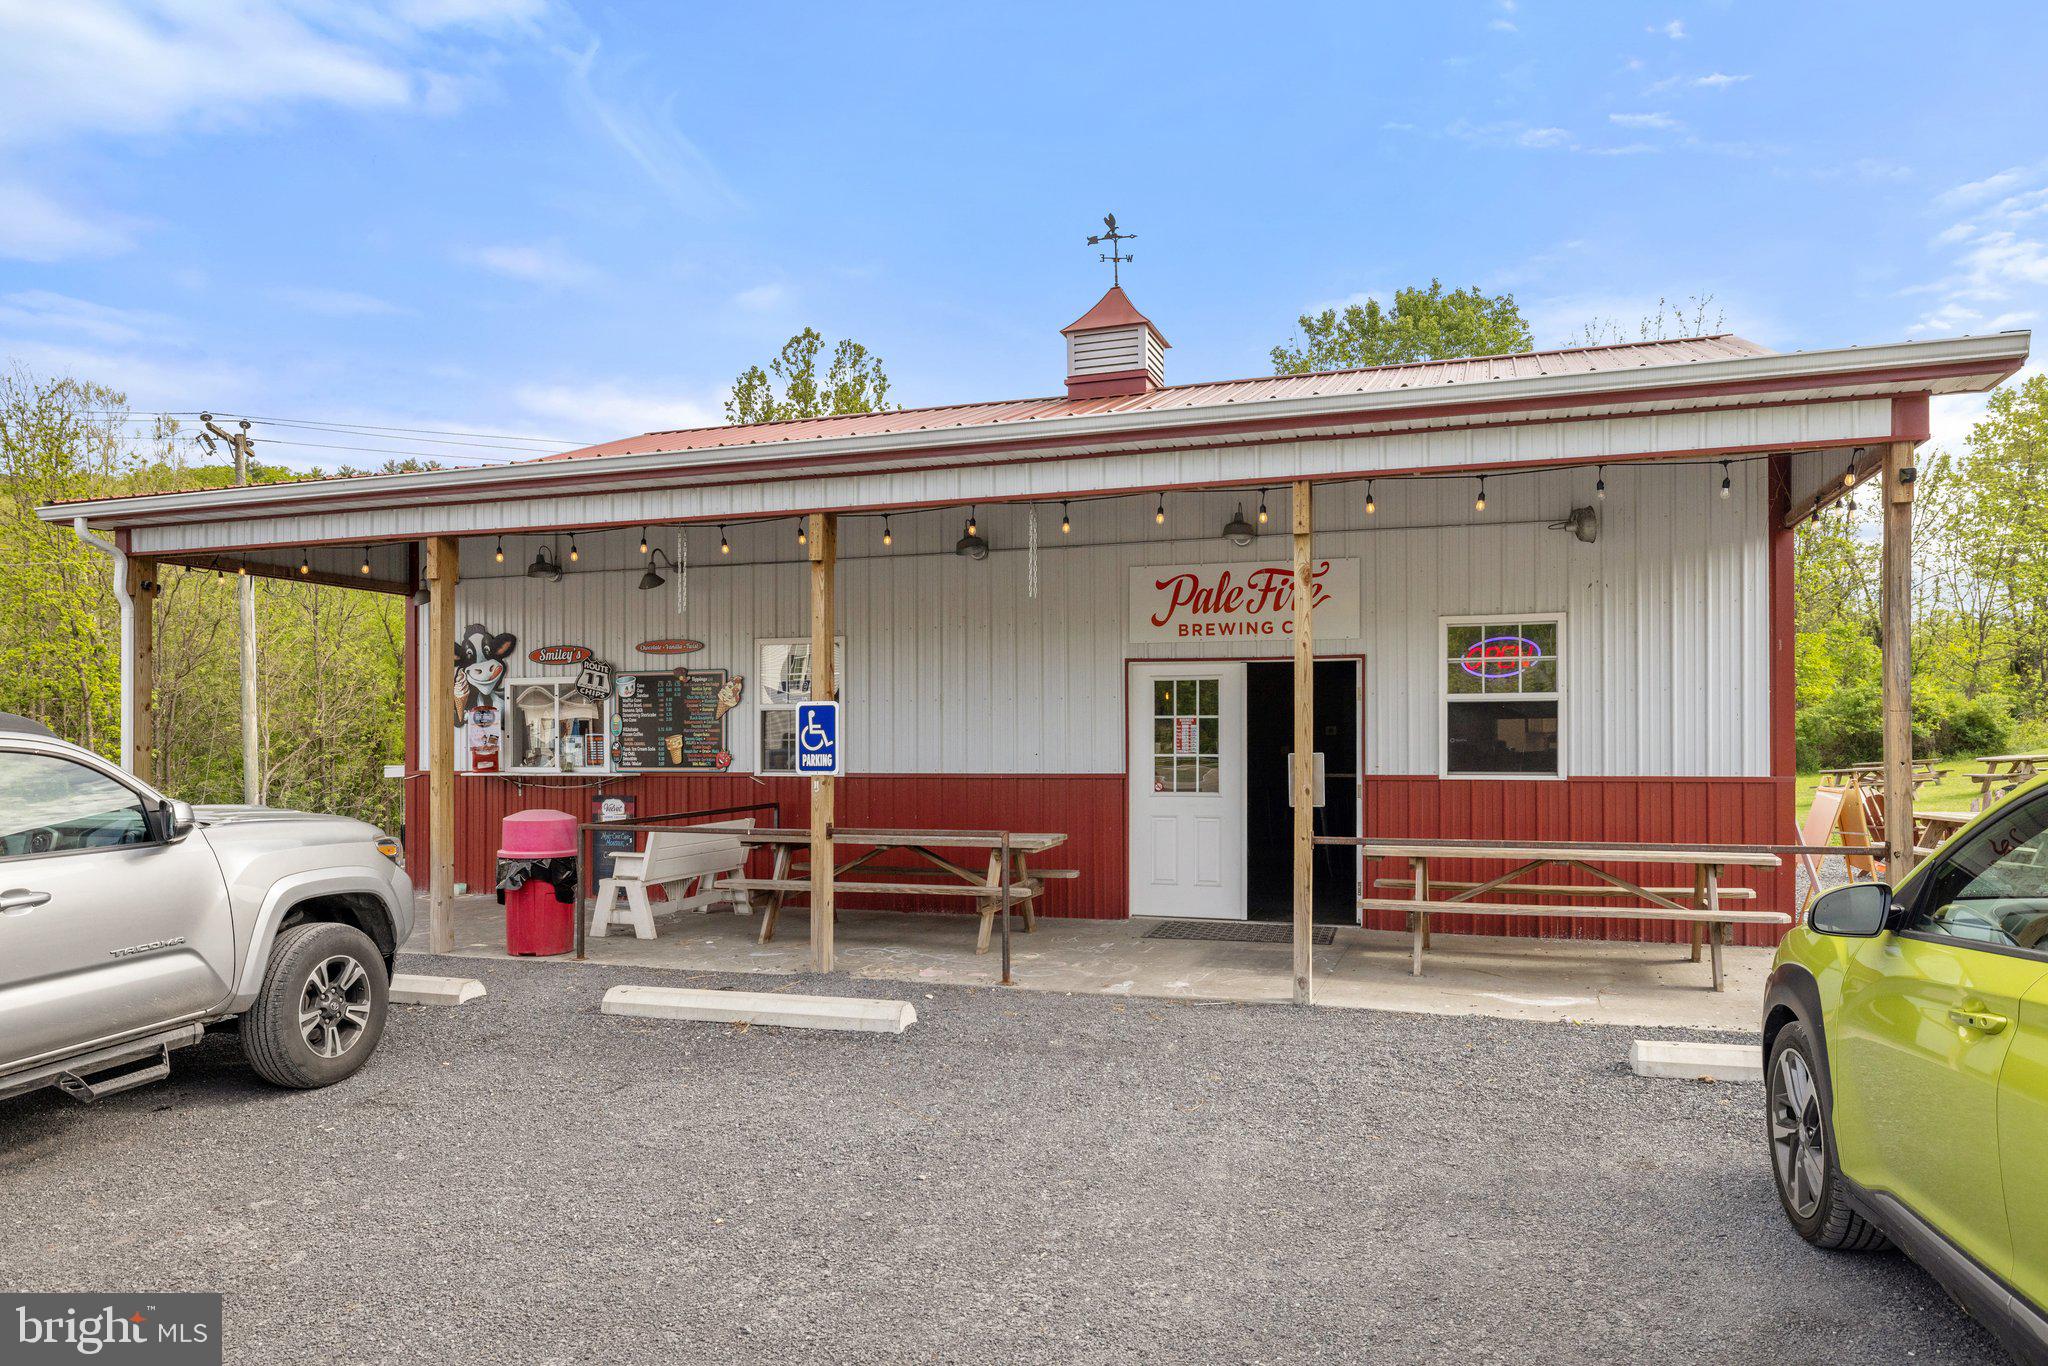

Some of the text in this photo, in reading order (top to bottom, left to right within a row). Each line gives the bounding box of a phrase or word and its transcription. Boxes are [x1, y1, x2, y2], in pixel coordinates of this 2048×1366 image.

[1151, 570, 1244, 627] Pale
[1178, 620, 1274, 637] BREWING
[539, 647, 582, 663] Smiley's
[1466, 645, 1534, 671] OPEN
[584, 660, 609, 673] ROUTE
[586, 672, 605, 687] 11
[580, 687, 606, 698] CHIPS
[802, 753, 833, 767] PARKING
[109, 936, 186, 958] TACOMA
